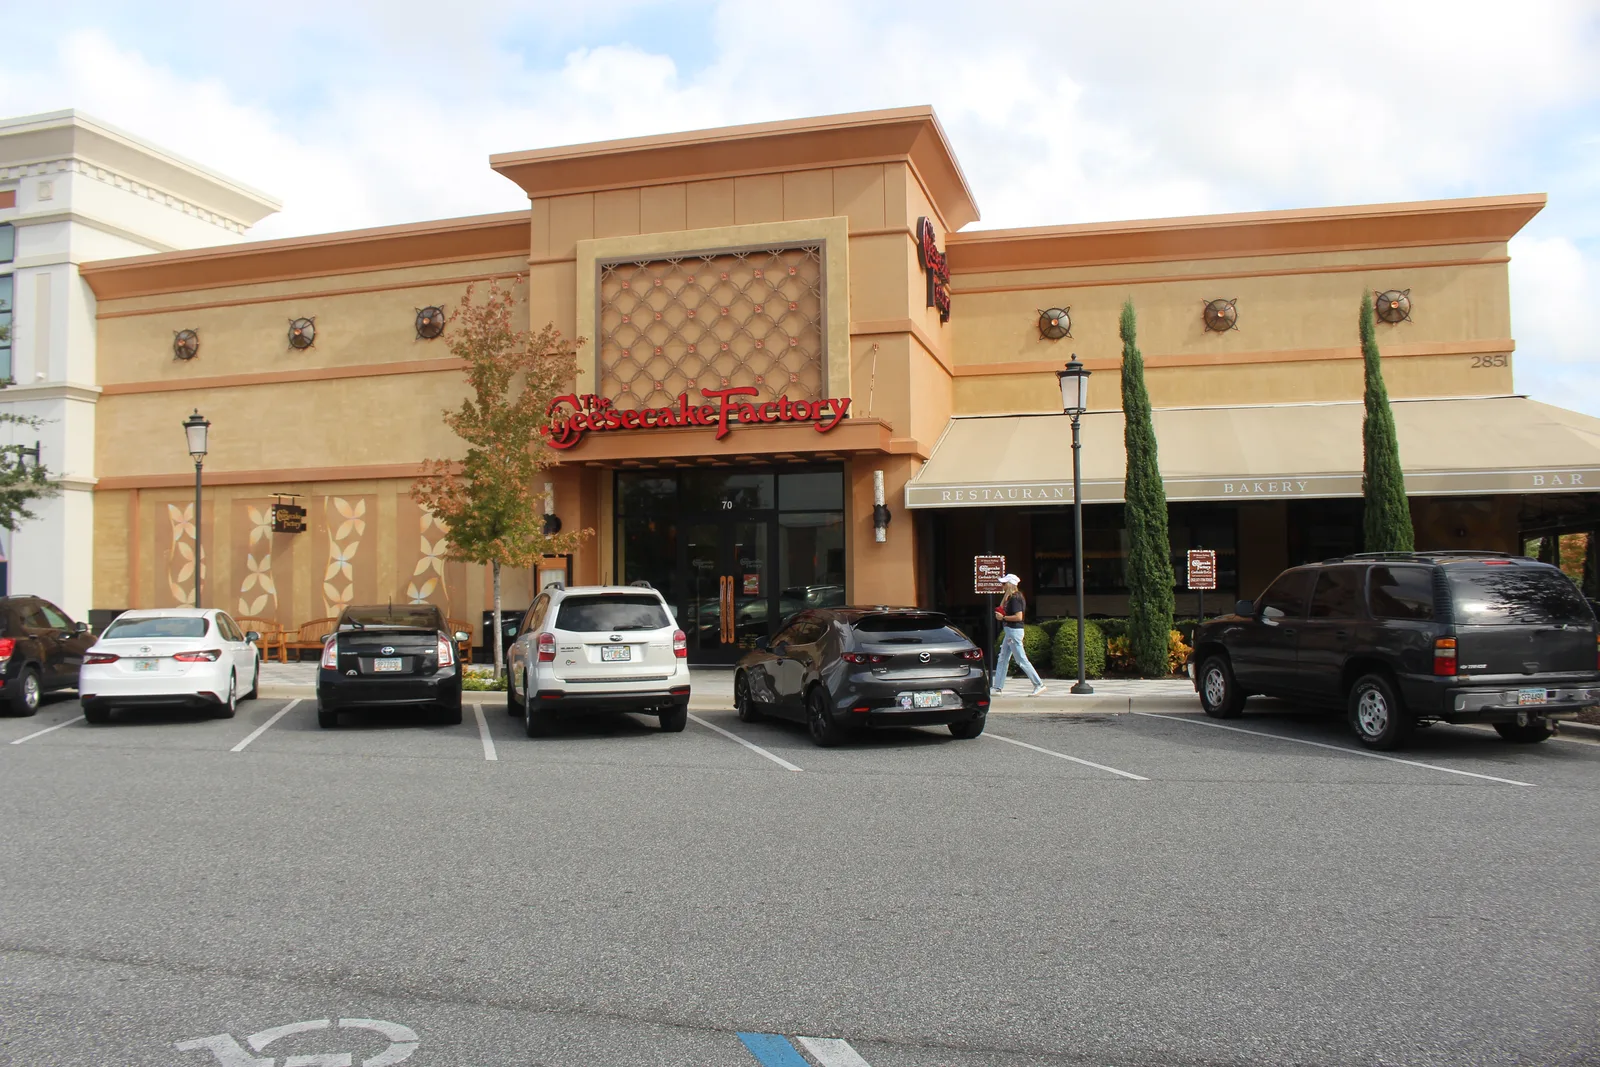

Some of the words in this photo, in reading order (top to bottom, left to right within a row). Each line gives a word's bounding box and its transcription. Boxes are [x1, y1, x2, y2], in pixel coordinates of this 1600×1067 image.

[1471, 355, 1508, 368] 2851
[579, 393, 612, 412] The
[701, 386, 851, 440] Factory
[1533, 473, 1584, 486] BAR
[1223, 481, 1308, 493] BAKERY
[722, 500, 733, 510] 70
